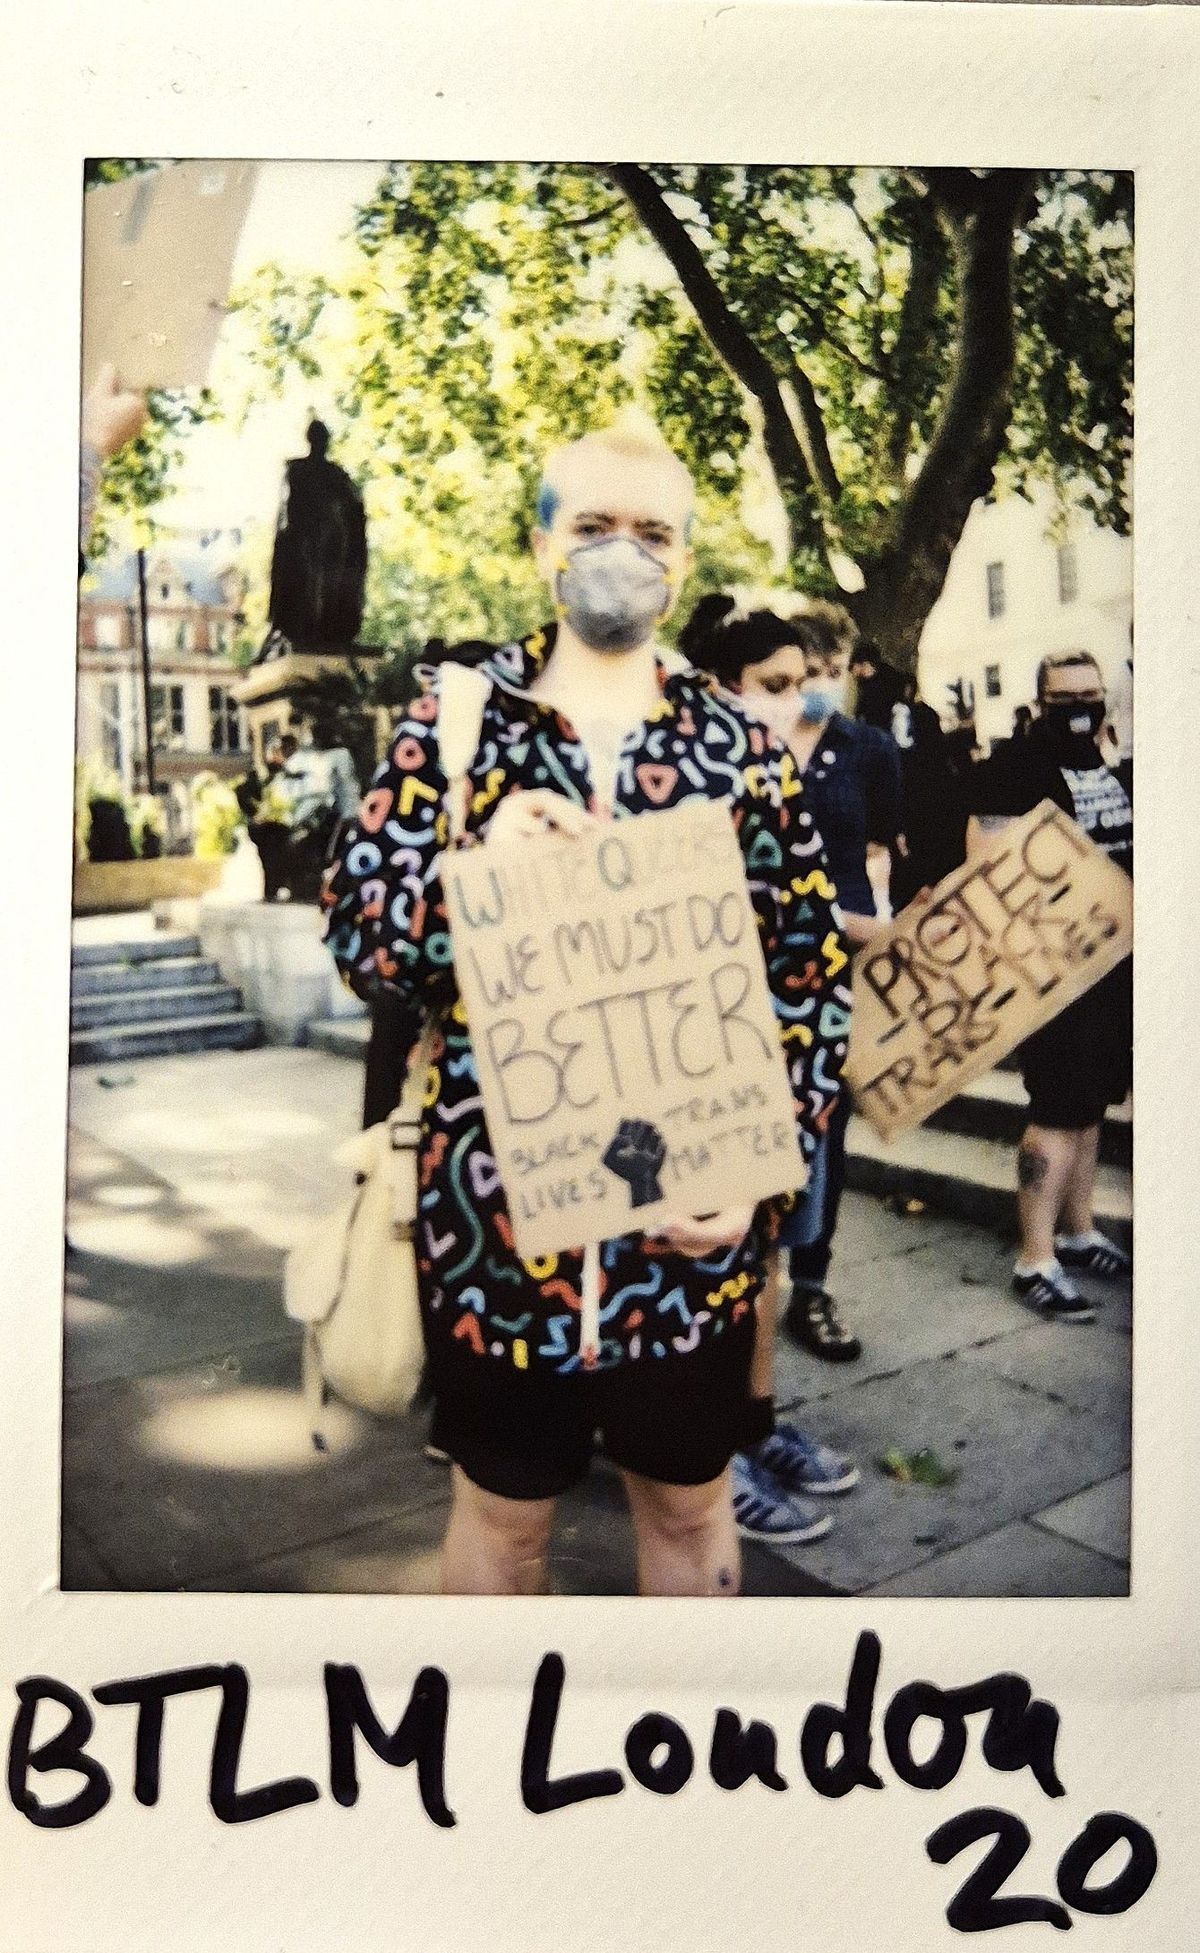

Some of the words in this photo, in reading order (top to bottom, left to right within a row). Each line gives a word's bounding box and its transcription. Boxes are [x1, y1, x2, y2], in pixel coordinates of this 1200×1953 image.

[470, 935, 543, 1008] WE
[553, 904, 678, 985] MUST
[688, 892, 747, 952] DO
[862, 811, 1088, 1018] PROTECT
[486, 962, 773, 1125] BETTER
[511, 1134, 601, 1175] BLACK
[664, 1083, 768, 1128] TRANS
[520, 1169, 608, 1220] LIVES
[669, 1121, 790, 1181] MATTER
[8, 1661, 457, 1829] BTLM
[520, 1630, 1066, 1815] London
[926, 1807, 1158, 1933] 20
